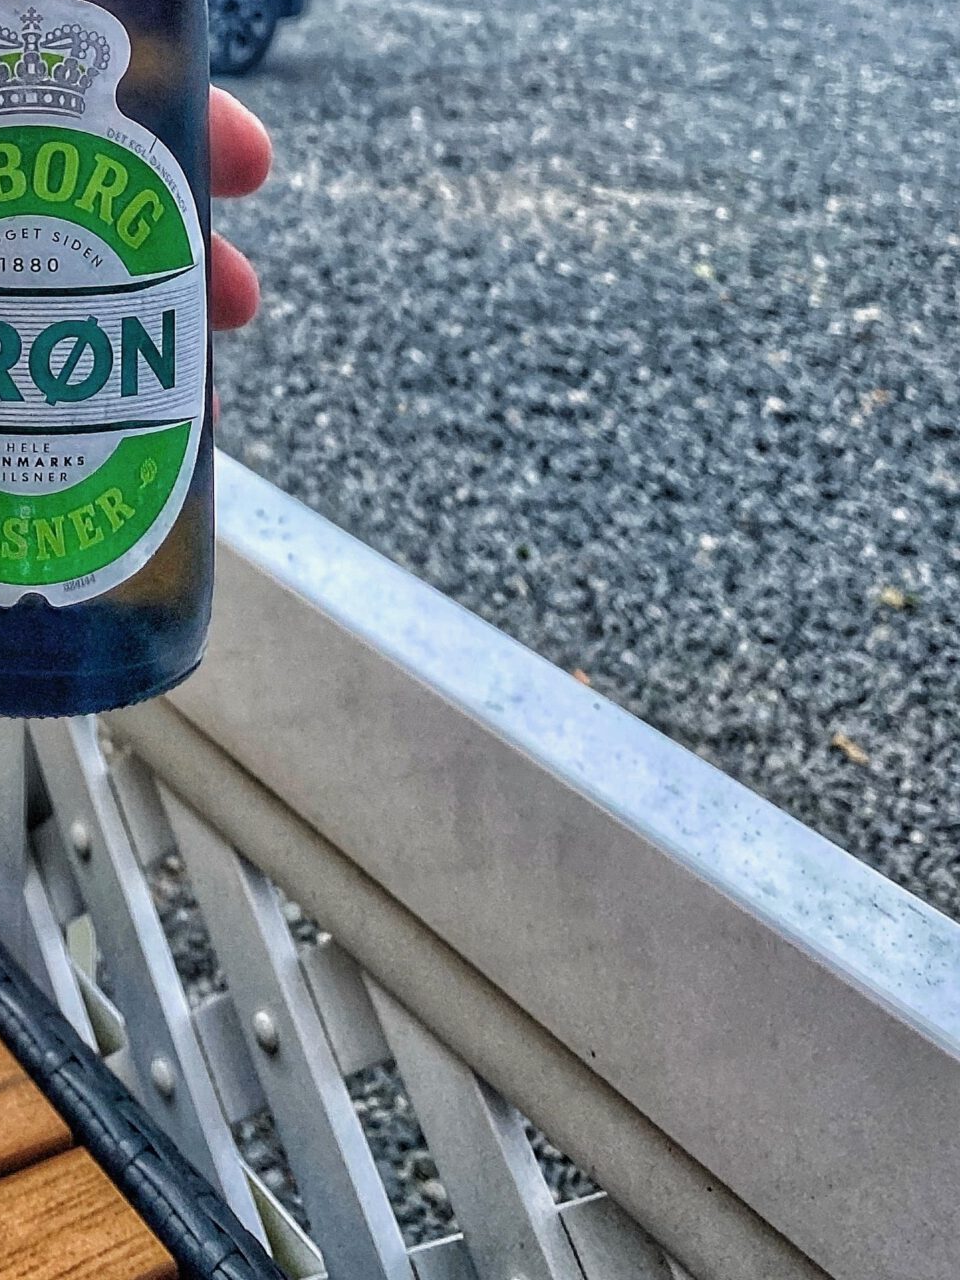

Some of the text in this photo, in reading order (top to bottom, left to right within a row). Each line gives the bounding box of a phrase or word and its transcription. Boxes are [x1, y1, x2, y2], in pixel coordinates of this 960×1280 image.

[106, 128, 128, 144] DET
[52, 231, 103, 268] SIDEN
[0, 257, 59, 272] 1880
[6, 442, 51, 453] HELE
